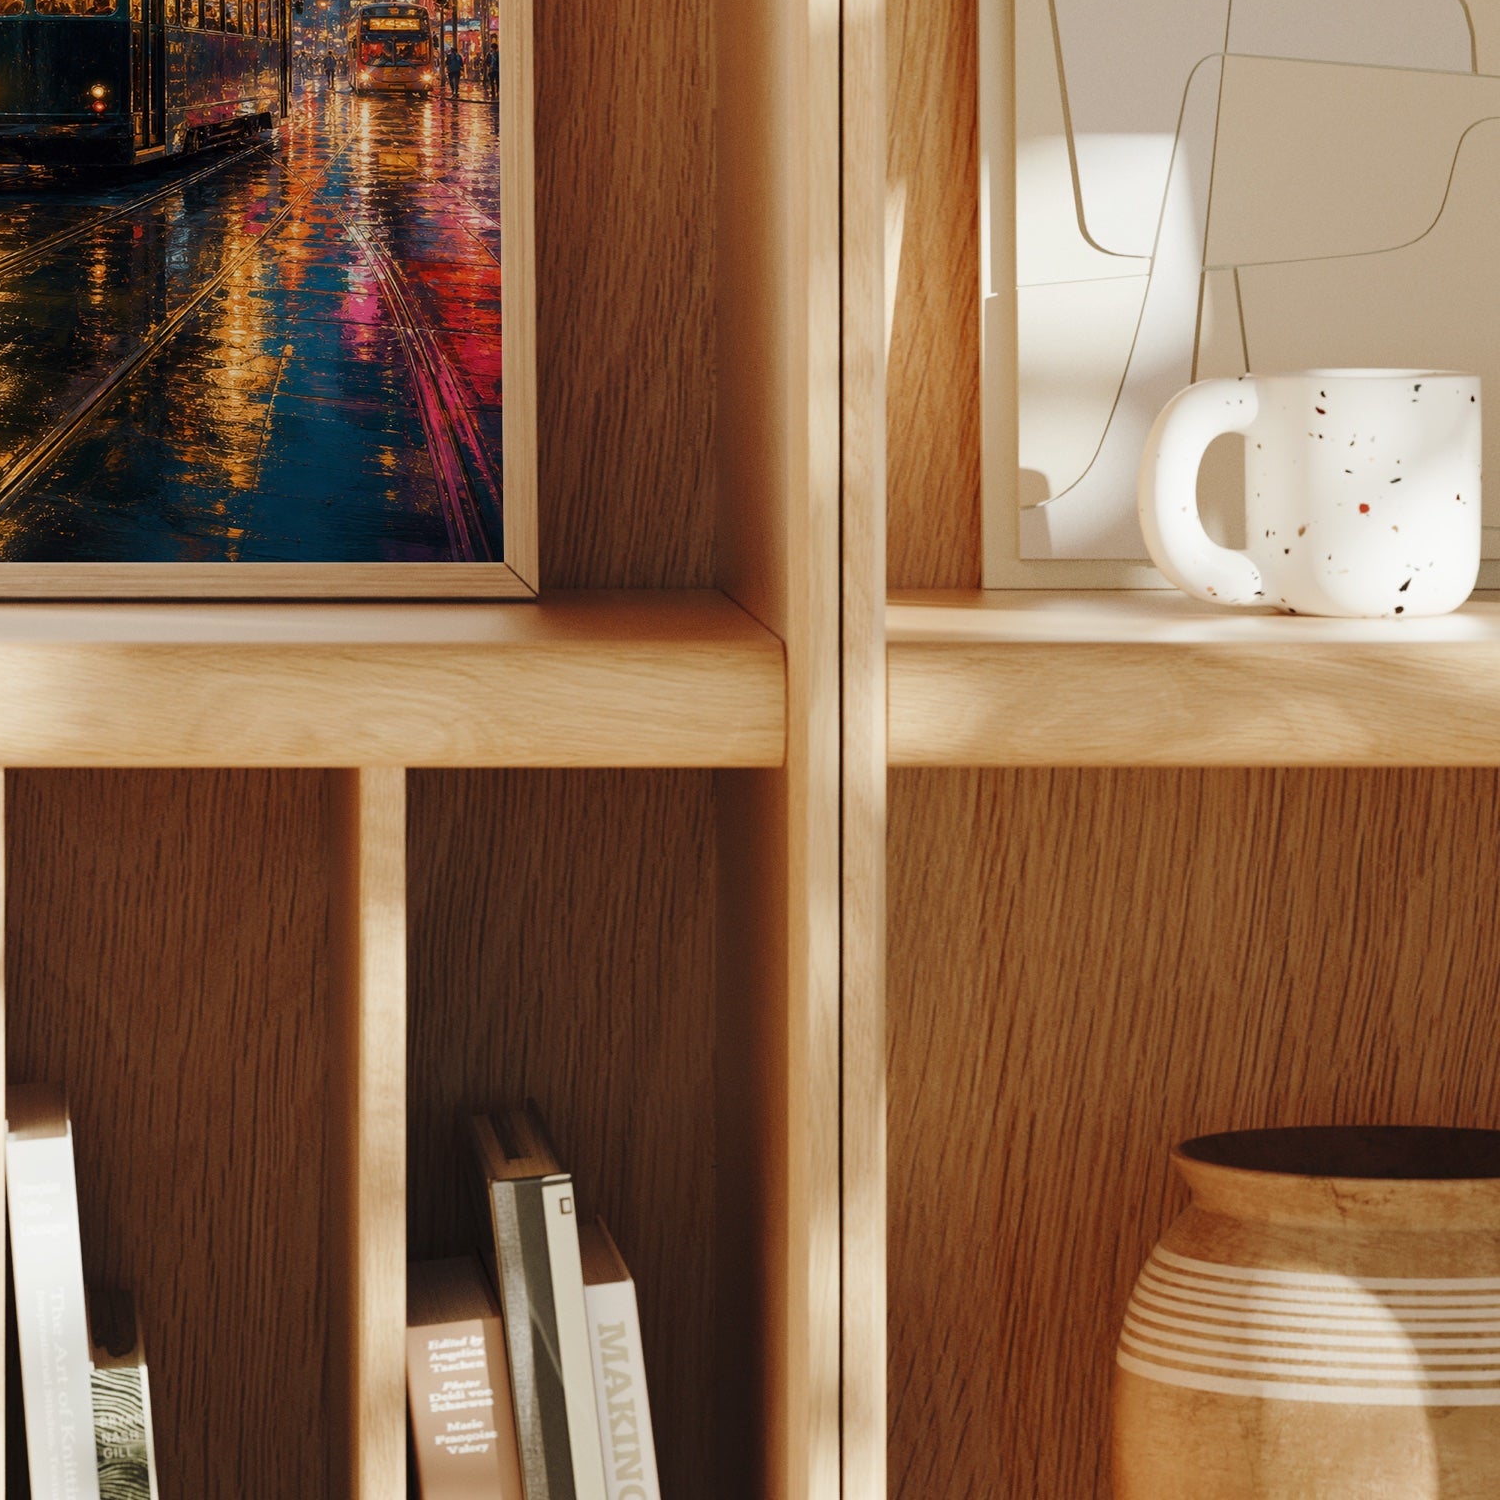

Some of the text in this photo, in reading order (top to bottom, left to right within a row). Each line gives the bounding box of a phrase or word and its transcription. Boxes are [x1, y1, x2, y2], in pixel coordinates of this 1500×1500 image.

[428, 1335, 484, 1350] Edited by
[54, 1342, 69, 1385] Art
[430, 1360, 485, 1373] Taschen
[58, 1392, 74, 1418] of
[103, 1444, 133, 1459] GILL
